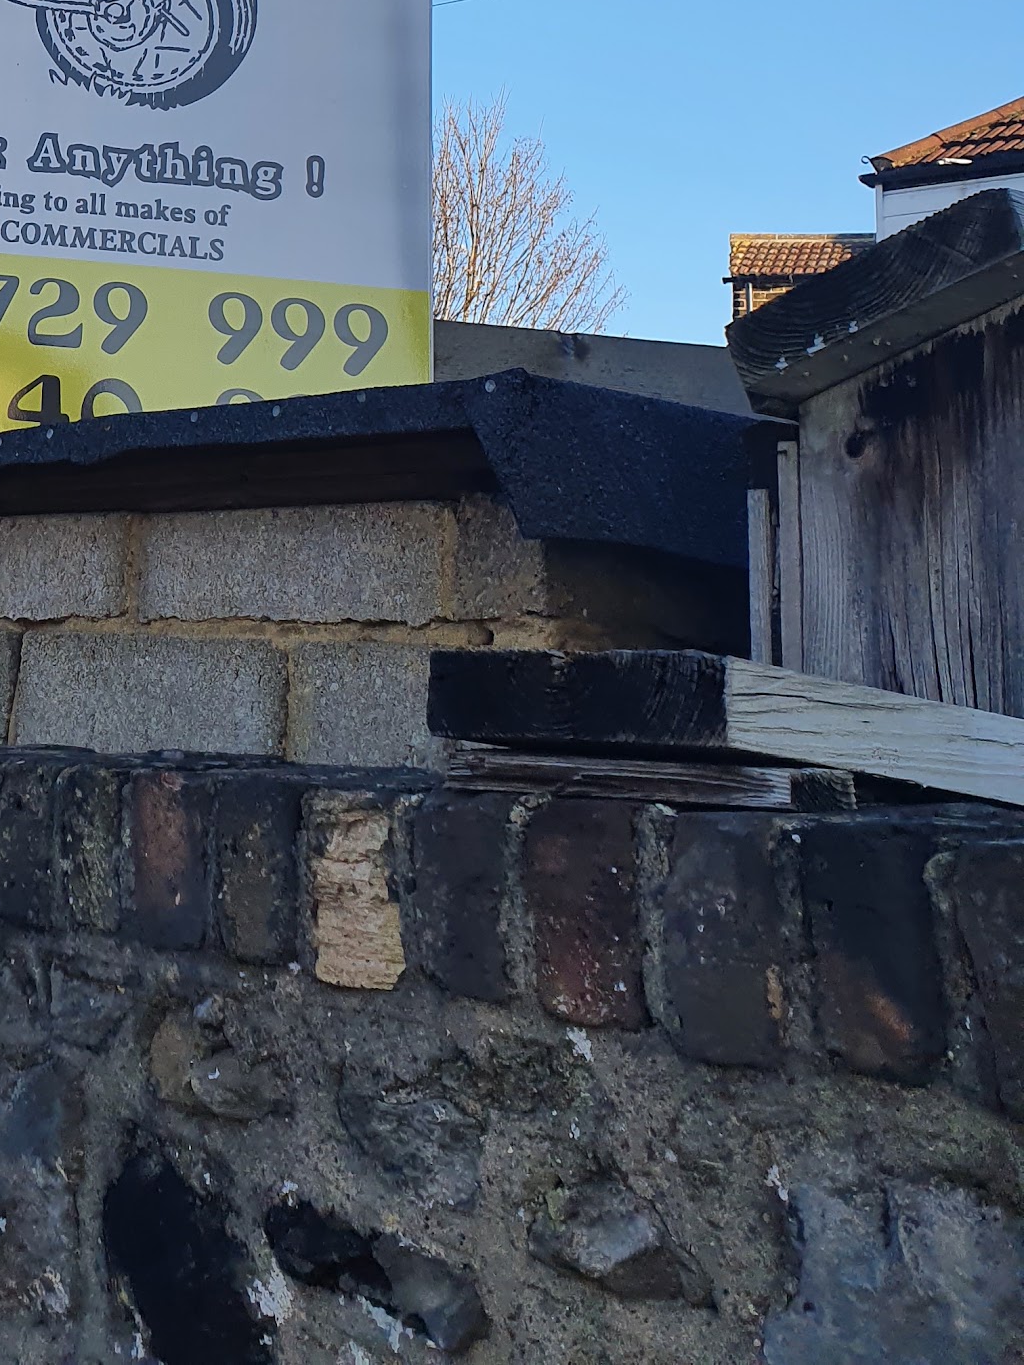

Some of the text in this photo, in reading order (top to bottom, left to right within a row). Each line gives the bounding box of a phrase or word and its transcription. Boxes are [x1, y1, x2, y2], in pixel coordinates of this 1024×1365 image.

[26, 132, 284, 201] Anything
[43, 191, 68, 212] to
[75, 192, 107, 216] all
[115, 198, 196, 224] makes
[204, 204, 232, 227] of
[0, 219, 225, 262] COMMERCIALS
[207, 291, 390, 378] 999
